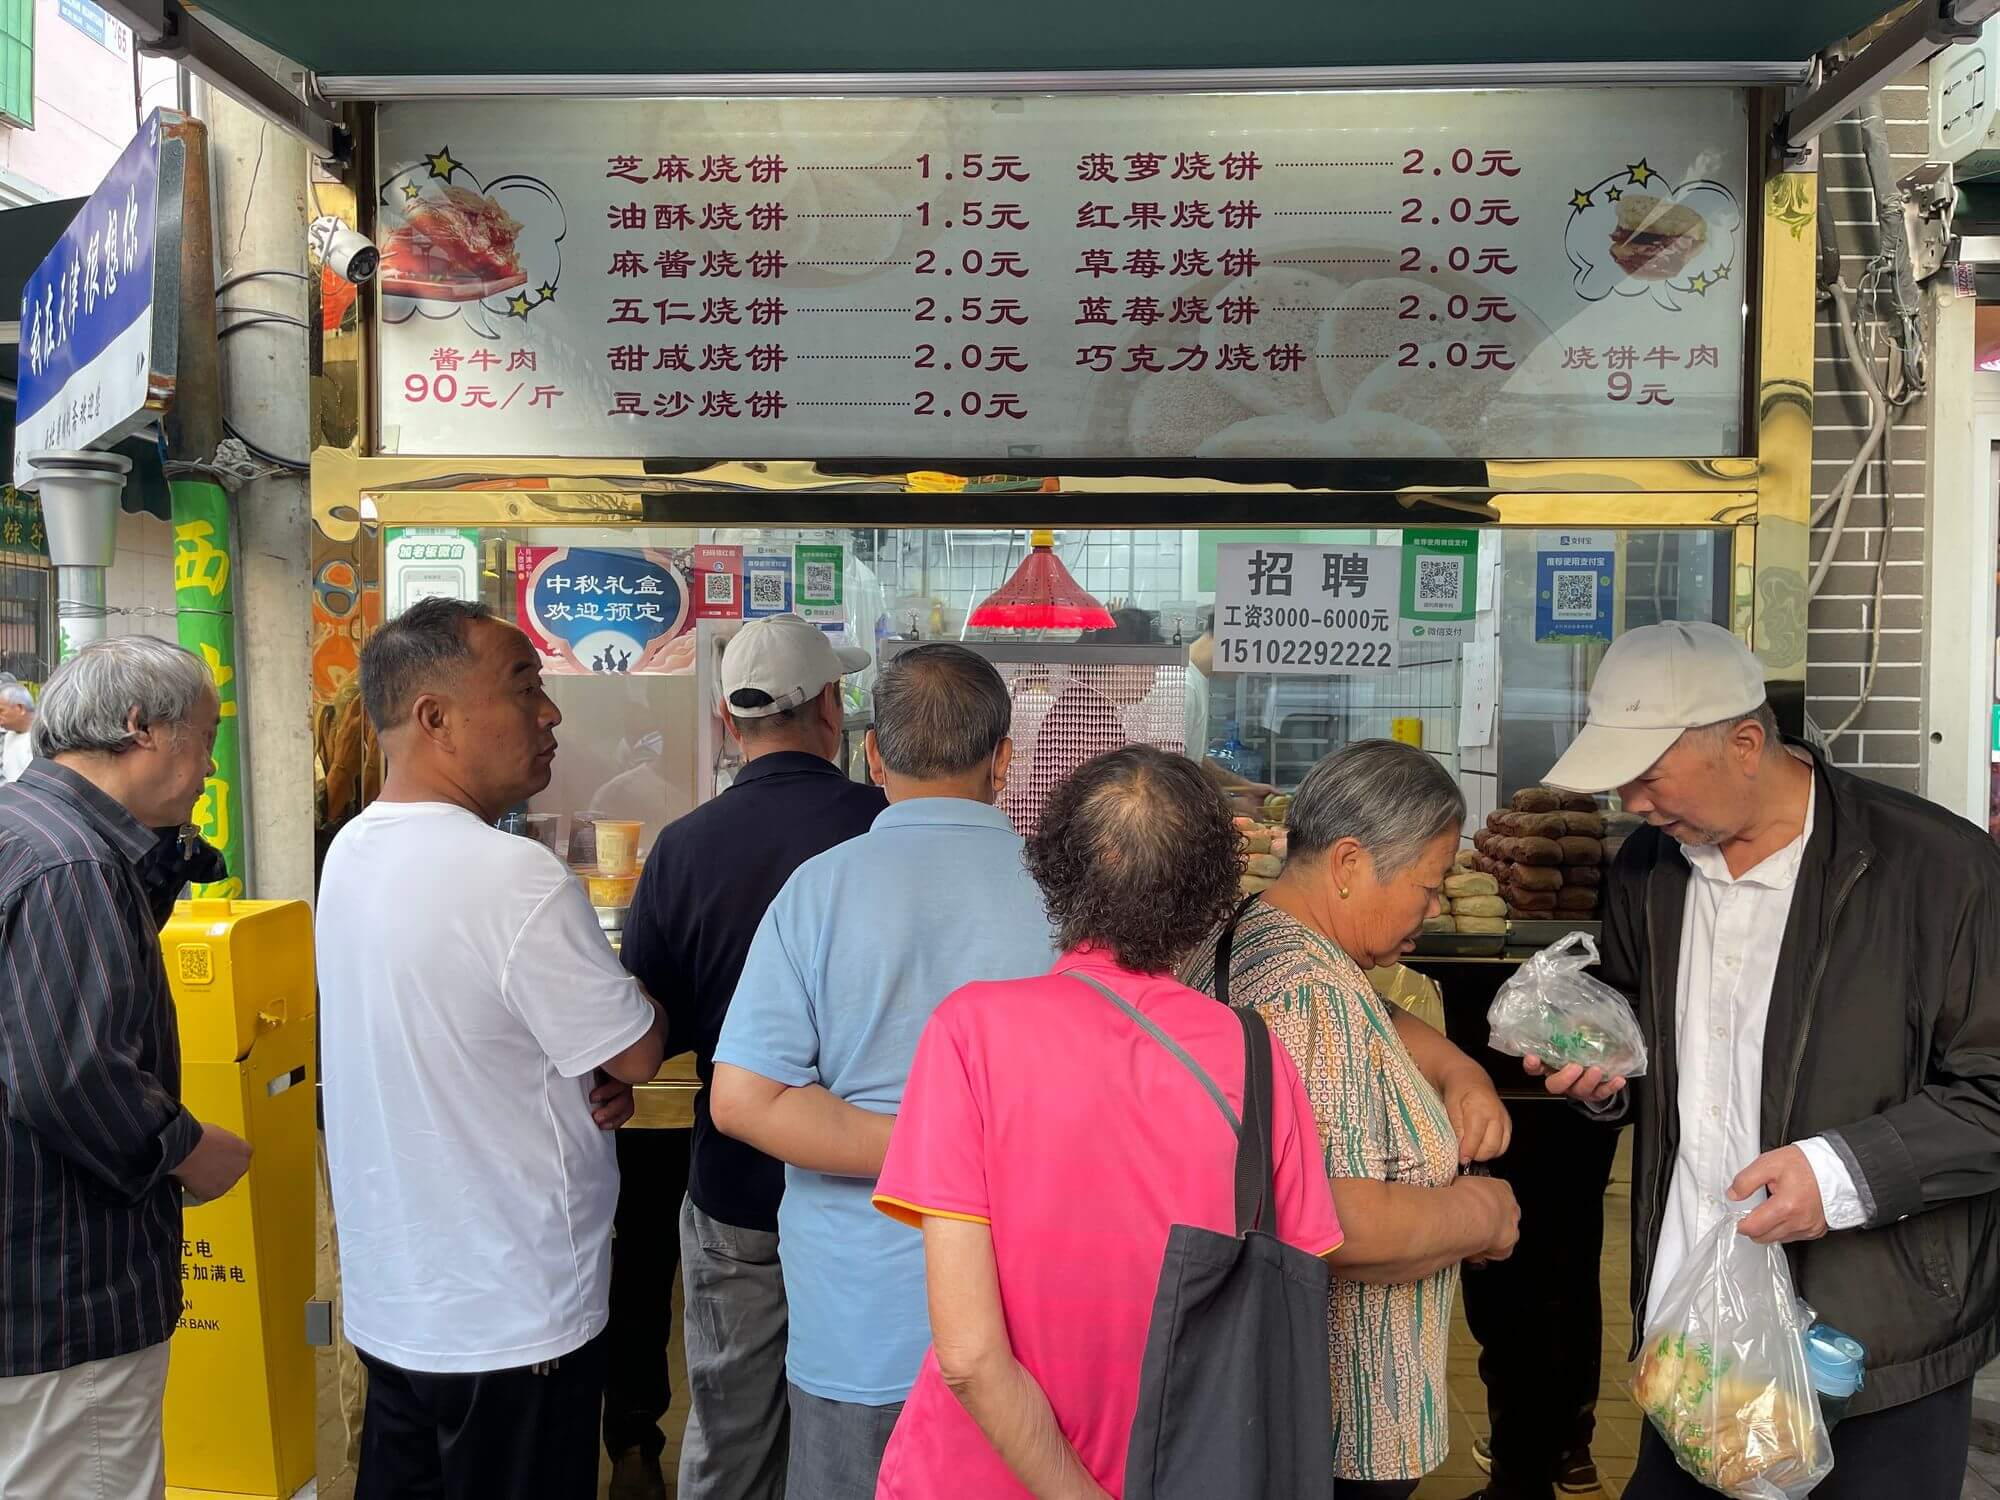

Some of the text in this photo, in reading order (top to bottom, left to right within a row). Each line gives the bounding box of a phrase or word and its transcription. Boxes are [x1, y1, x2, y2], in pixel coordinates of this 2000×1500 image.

[608, 153, 1030, 184] 芝麻烧饼 1.5元
[1076, 148, 1521, 184] 菠萝烧饼 2.0元
[607, 202, 1030, 232] 油酥烧饼 1.5元
[1076, 198, 1520, 231] 红果烧饼 2.0元
[607, 250, 1029, 279] 麻酱烧饼 2.0元
[1075, 247, 1517, 278] 草莓烧饼 2.0元
[31, 184, 138, 376] 我在天津很想你
[607, 297, 1029, 326] 五仁烧饼 2.5元
[1075, 295, 1517, 326] 蓝莓烧饼 2.0元
[429, 347, 537, 373] 酱牛肉
[607, 344, 1029, 373] 甜咸烧饼 2.0元
[1075, 343, 1515, 373] 巧克力烧饼 2.0元
[1561, 345, 1719, 370] 烧饼牛肉
[404, 373, 565, 410] 90元/斤
[1607, 371, 1675, 406] 9元
[607, 391, 1028, 420] 豆沙烧饼 2.0元
[399, 544, 464, 560] 加老板微信
[1546, 556, 1606, 567] 推荐使用支付宝
[546, 574, 665, 595] 中秋礼盒
[1248, 550, 1369, 598] 招聘
[543, 602, 665, 622] 欢迎预定
[1223, 604, 1389, 632] 工资3000-6000元
[1427, 626, 1463, 638] 微信支付
[1220, 638, 1392, 667] 15102292222
[189, 1318, 220, 1331] BANK
